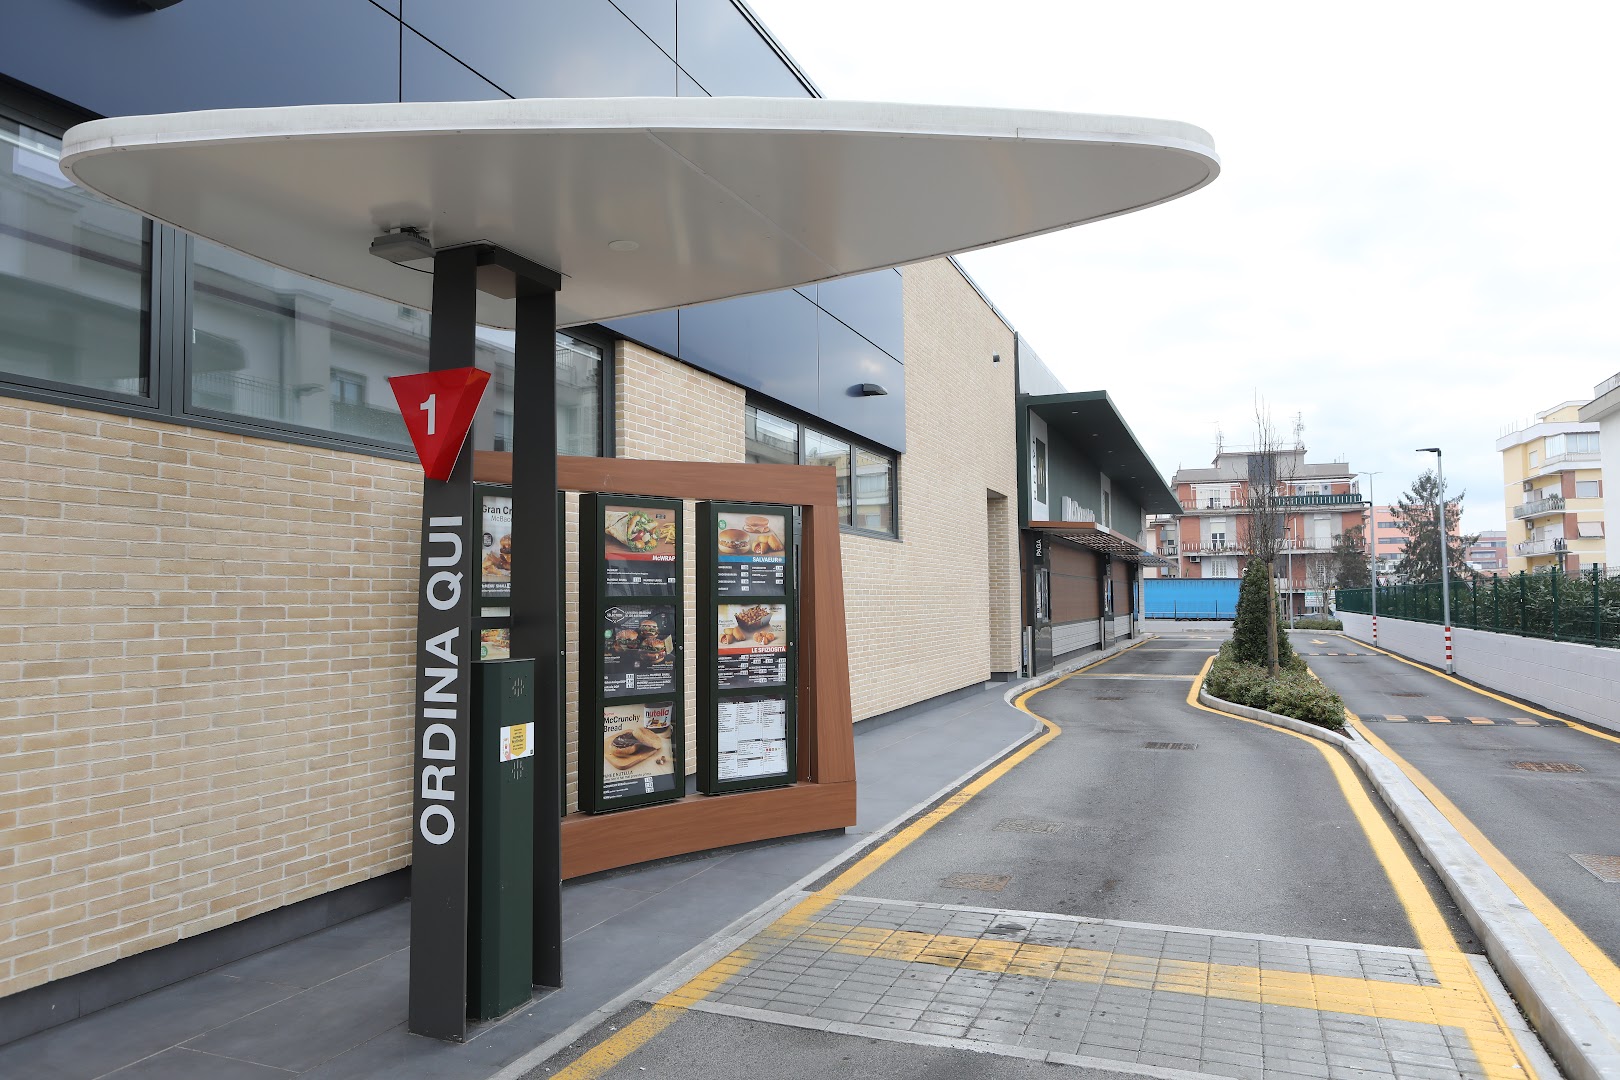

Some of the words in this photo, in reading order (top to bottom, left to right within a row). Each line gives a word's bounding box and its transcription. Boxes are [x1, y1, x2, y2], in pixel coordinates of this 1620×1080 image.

[420, 393, 436, 435] 1
[483, 505, 501, 514] Gran
[426, 516, 464, 611] QUI
[645, 708, 670, 718] nutella
[604, 714, 641, 724] McCrunchy
[604, 724, 623, 733] Bread
[419, 626, 460, 845] ORDINA
